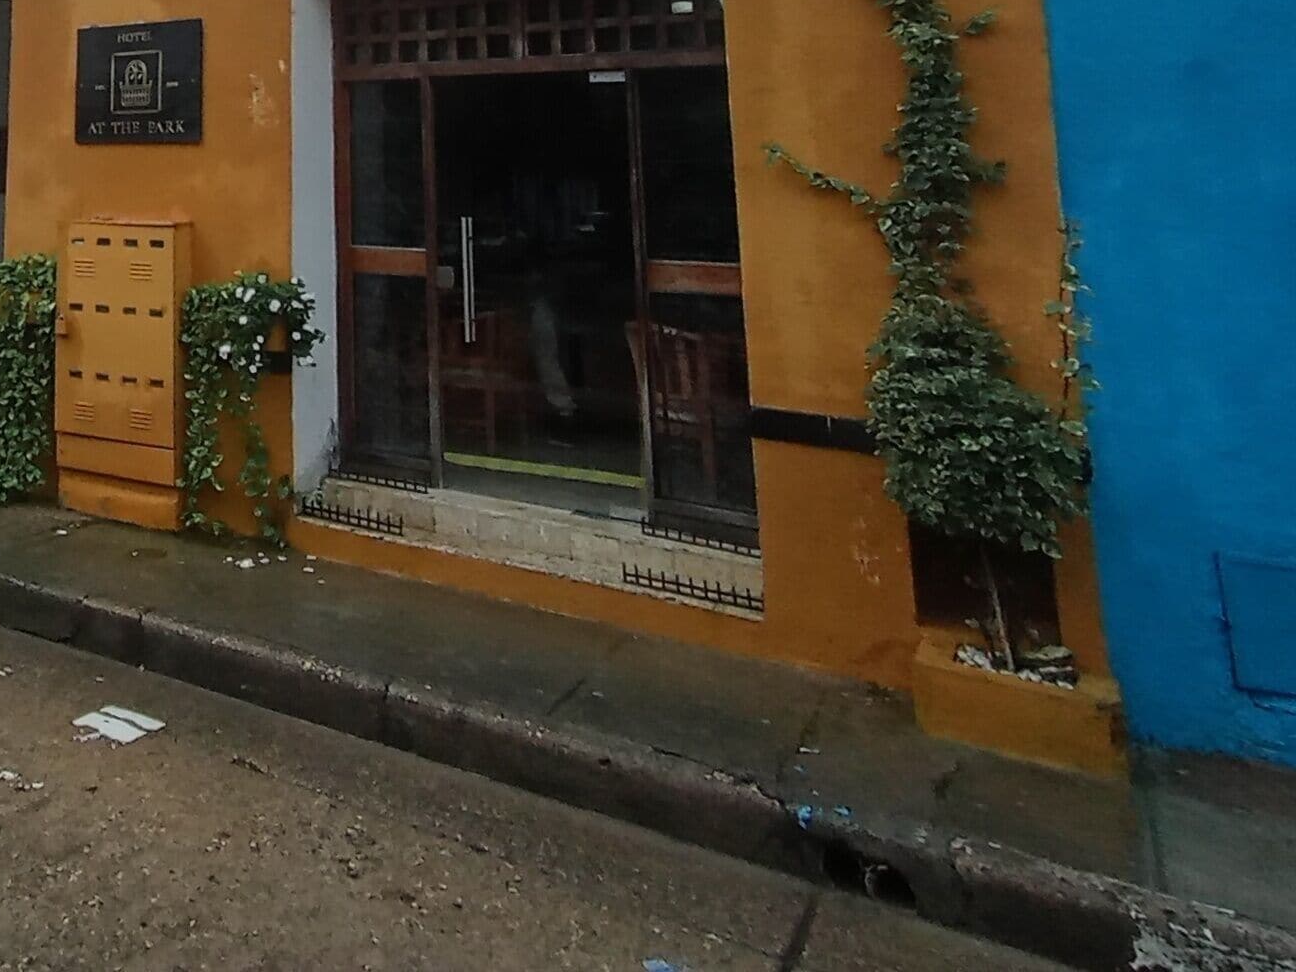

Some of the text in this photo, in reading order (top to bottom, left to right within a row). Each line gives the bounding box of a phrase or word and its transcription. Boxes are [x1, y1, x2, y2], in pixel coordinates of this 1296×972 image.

[117, 31, 152, 43] HOTEL
[88, 119, 185, 134] AT THE PARK
